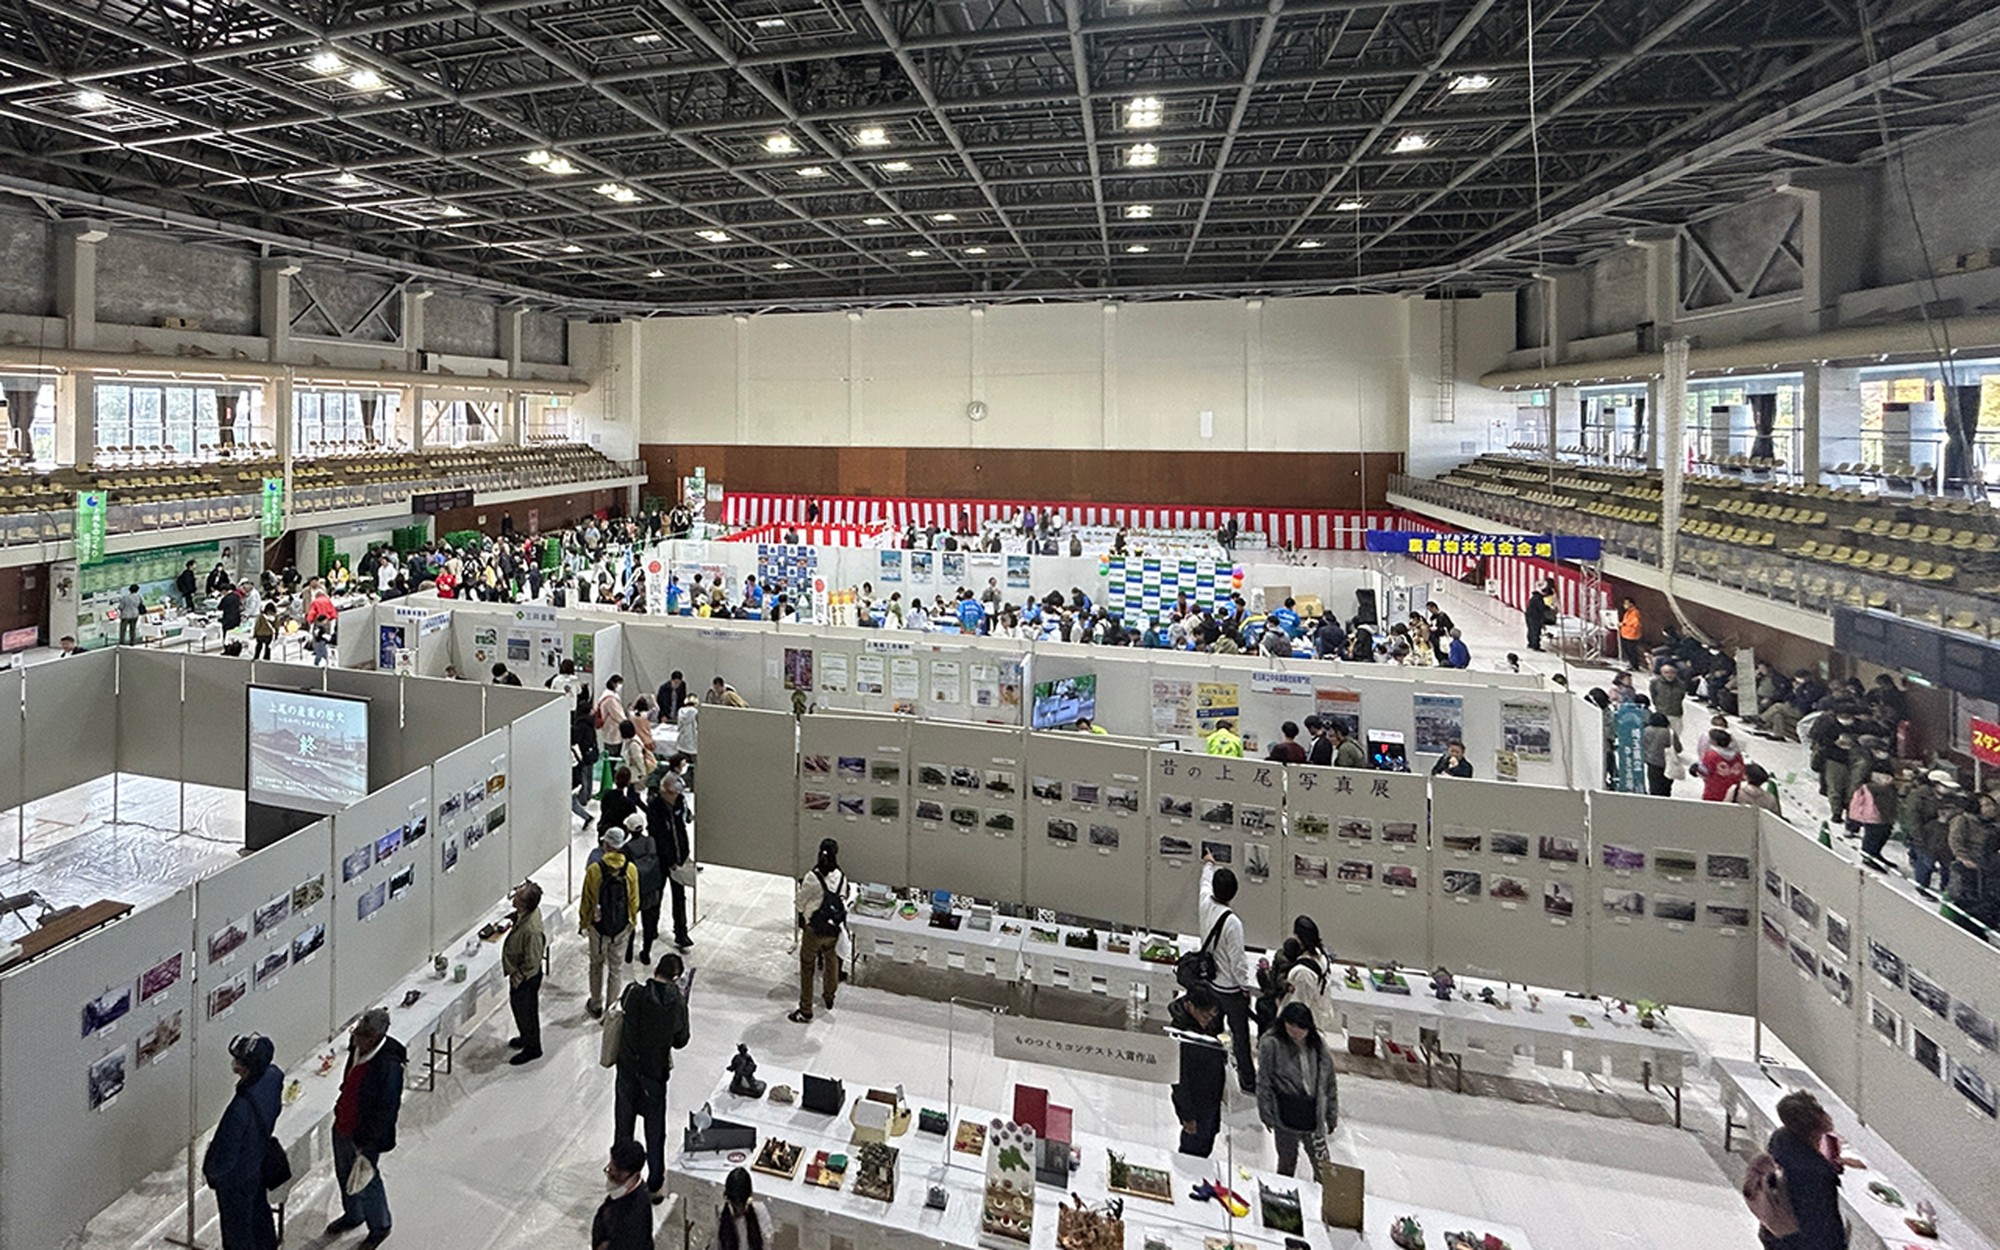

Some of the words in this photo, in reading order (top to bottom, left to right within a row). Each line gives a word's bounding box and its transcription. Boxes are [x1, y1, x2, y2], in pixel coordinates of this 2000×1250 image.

[1408, 538, 1552, 557] 農産物共進会会場
[1160, 759, 1390, 798] 昔の上尾写真展
